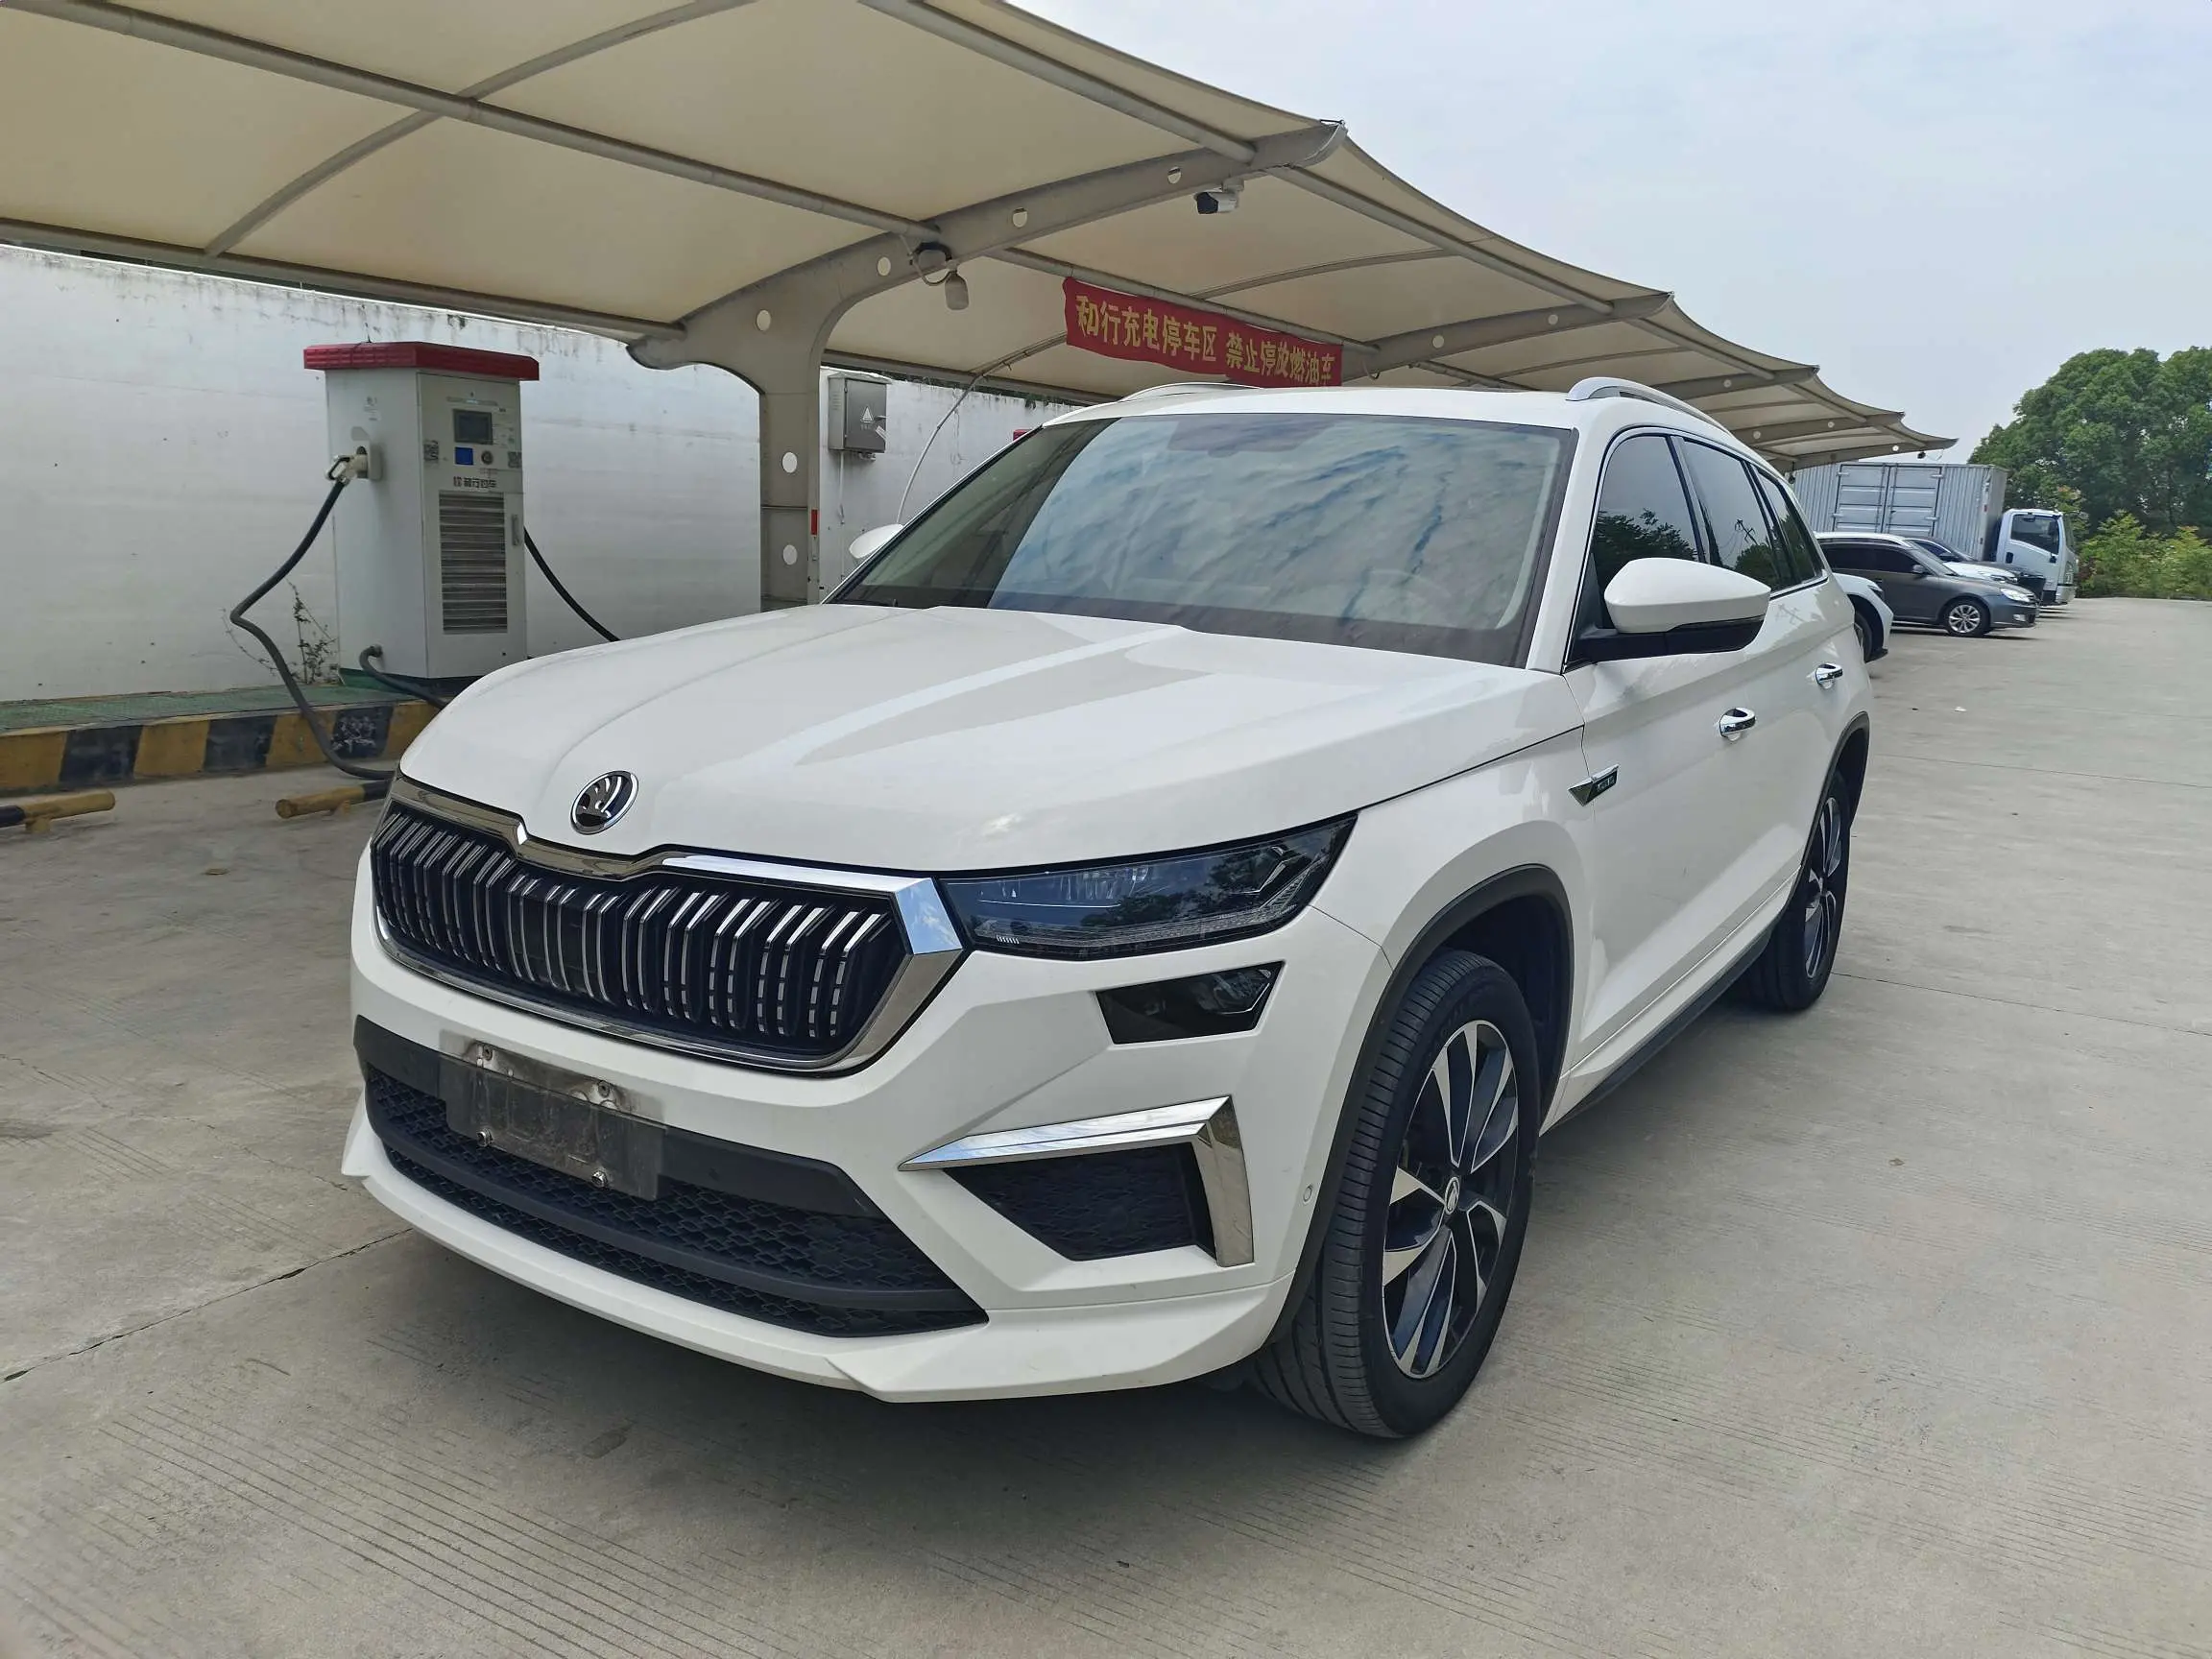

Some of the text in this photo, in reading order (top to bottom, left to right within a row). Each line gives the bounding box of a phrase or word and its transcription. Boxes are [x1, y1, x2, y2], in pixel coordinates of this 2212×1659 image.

[1075, 295, 1335, 386] 和行充电停车区 禁止停放燃油车
